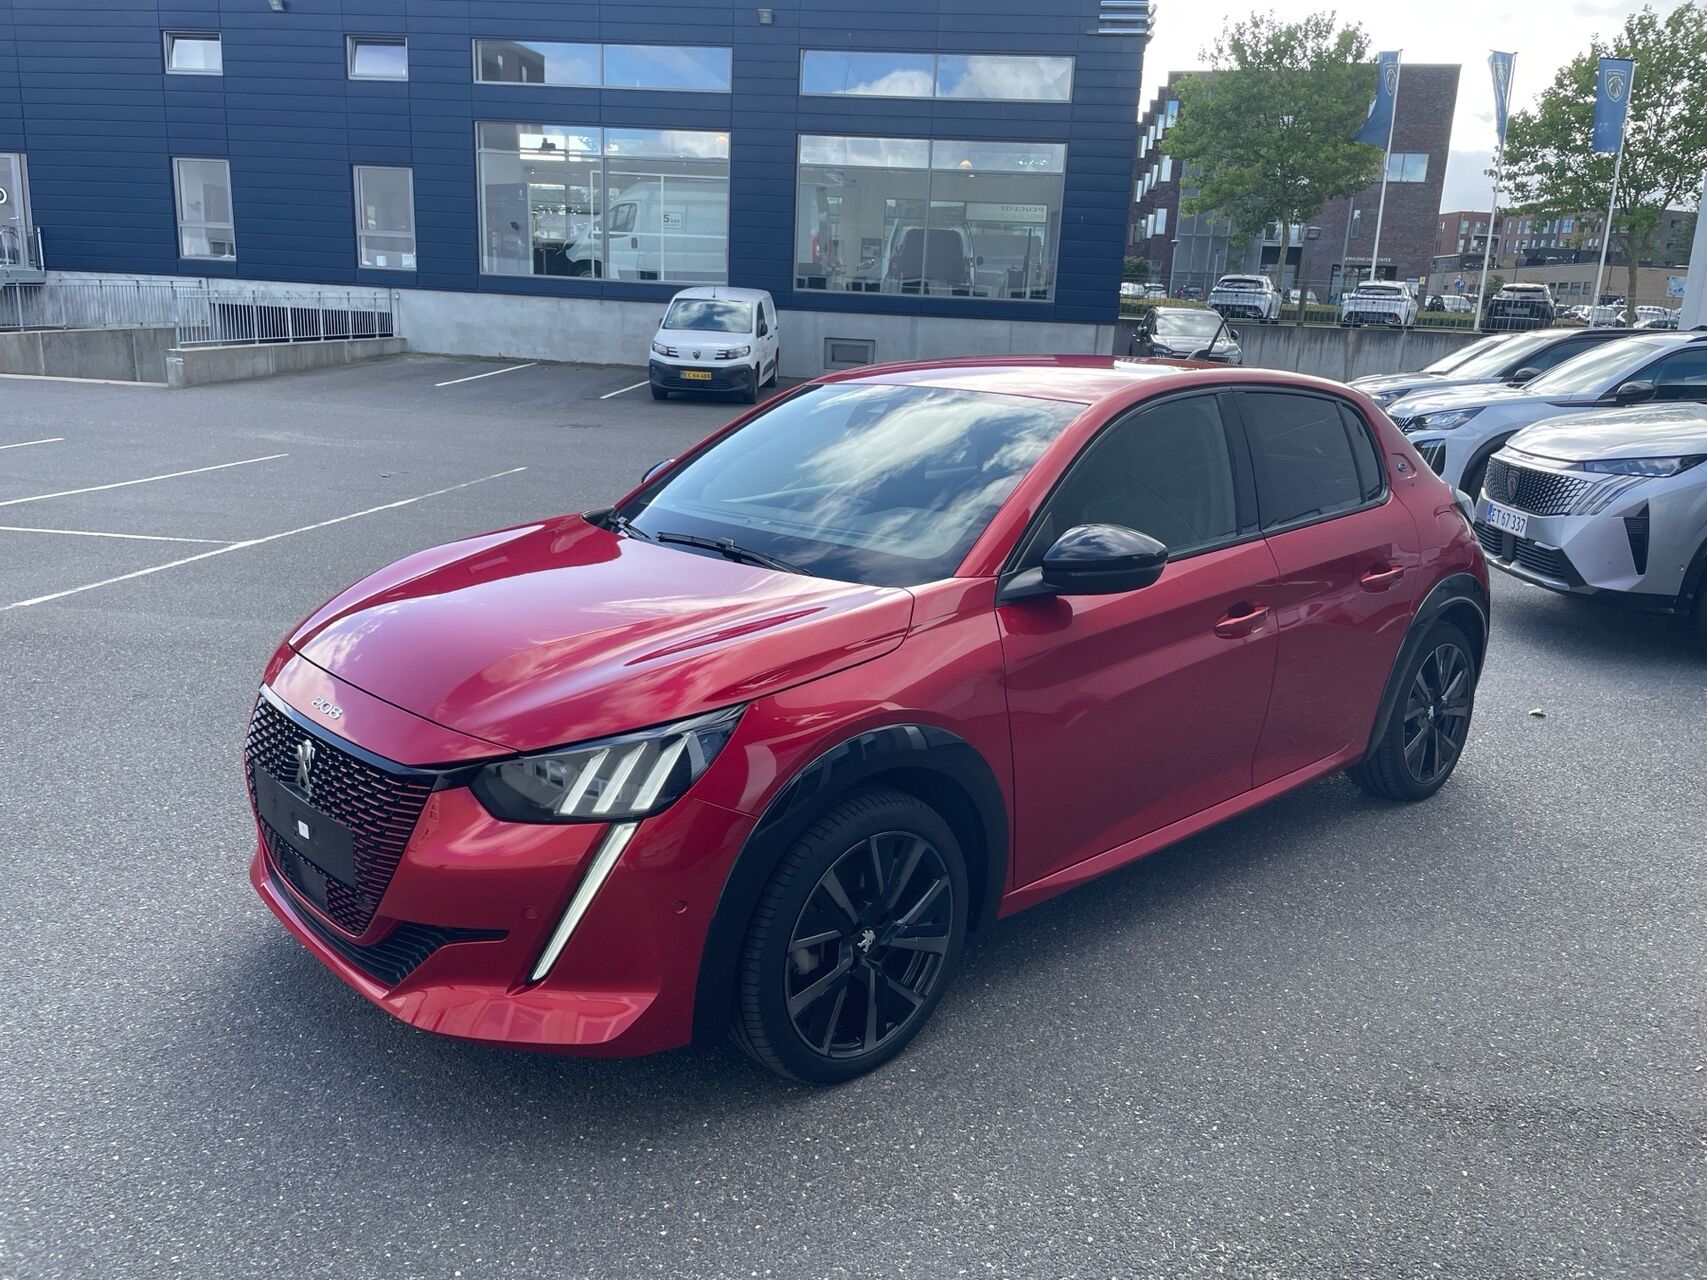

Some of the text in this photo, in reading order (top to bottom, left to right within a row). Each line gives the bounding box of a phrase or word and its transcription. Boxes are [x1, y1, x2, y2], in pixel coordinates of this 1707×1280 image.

[1491, 508, 1526, 533] ET 67 337
[311, 696, 343, 720] 208
